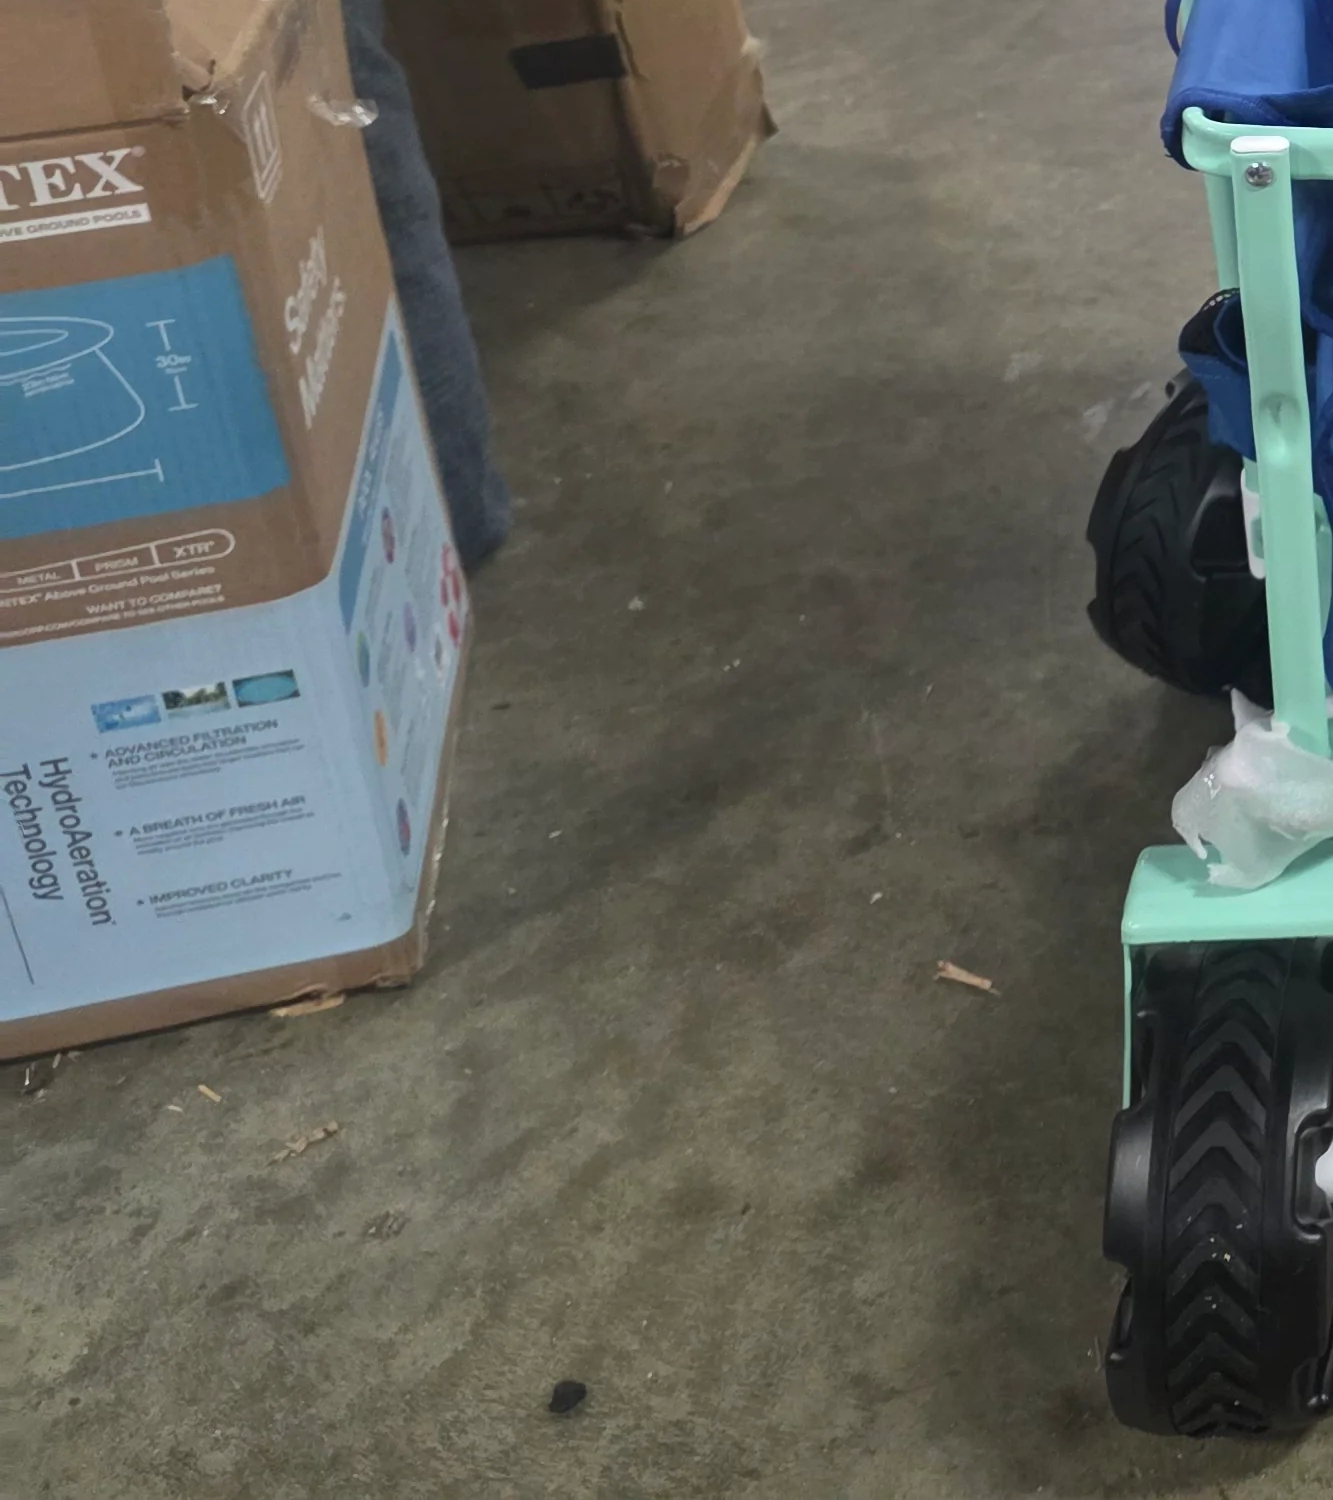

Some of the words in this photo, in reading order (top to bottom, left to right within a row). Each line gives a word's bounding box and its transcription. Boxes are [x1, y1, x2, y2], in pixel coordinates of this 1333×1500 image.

[27, 216, 90, 234] GROUND
[93, 209, 142, 225] POOLS
[17, 572, 60, 585] METAL
[95, 556, 139, 571] PRISM
[44, 588, 86, 602] Above
[88, 578, 138, 593] Ground
[140, 573, 169, 586] Pool
[171, 566, 215, 579] Series
[86, 601, 124, 614] WANT
[130, 596, 148, 607] TO
[105, 734, 189, 759] ADVANCED
[193, 719, 279, 743] FILTRATION
[108, 754, 141, 769] AND
[144, 736, 247, 762] CIRCULATION
[0, 762, 64, 900] Technology
[143, 815, 203, 835] BREATH
[205, 809, 226, 822] OF
[229, 800, 279, 818] FRESH
[281, 795, 306, 807] AIR
[149, 881, 228, 905] IMPROVED
[230, 869, 293, 889] CLARITY
